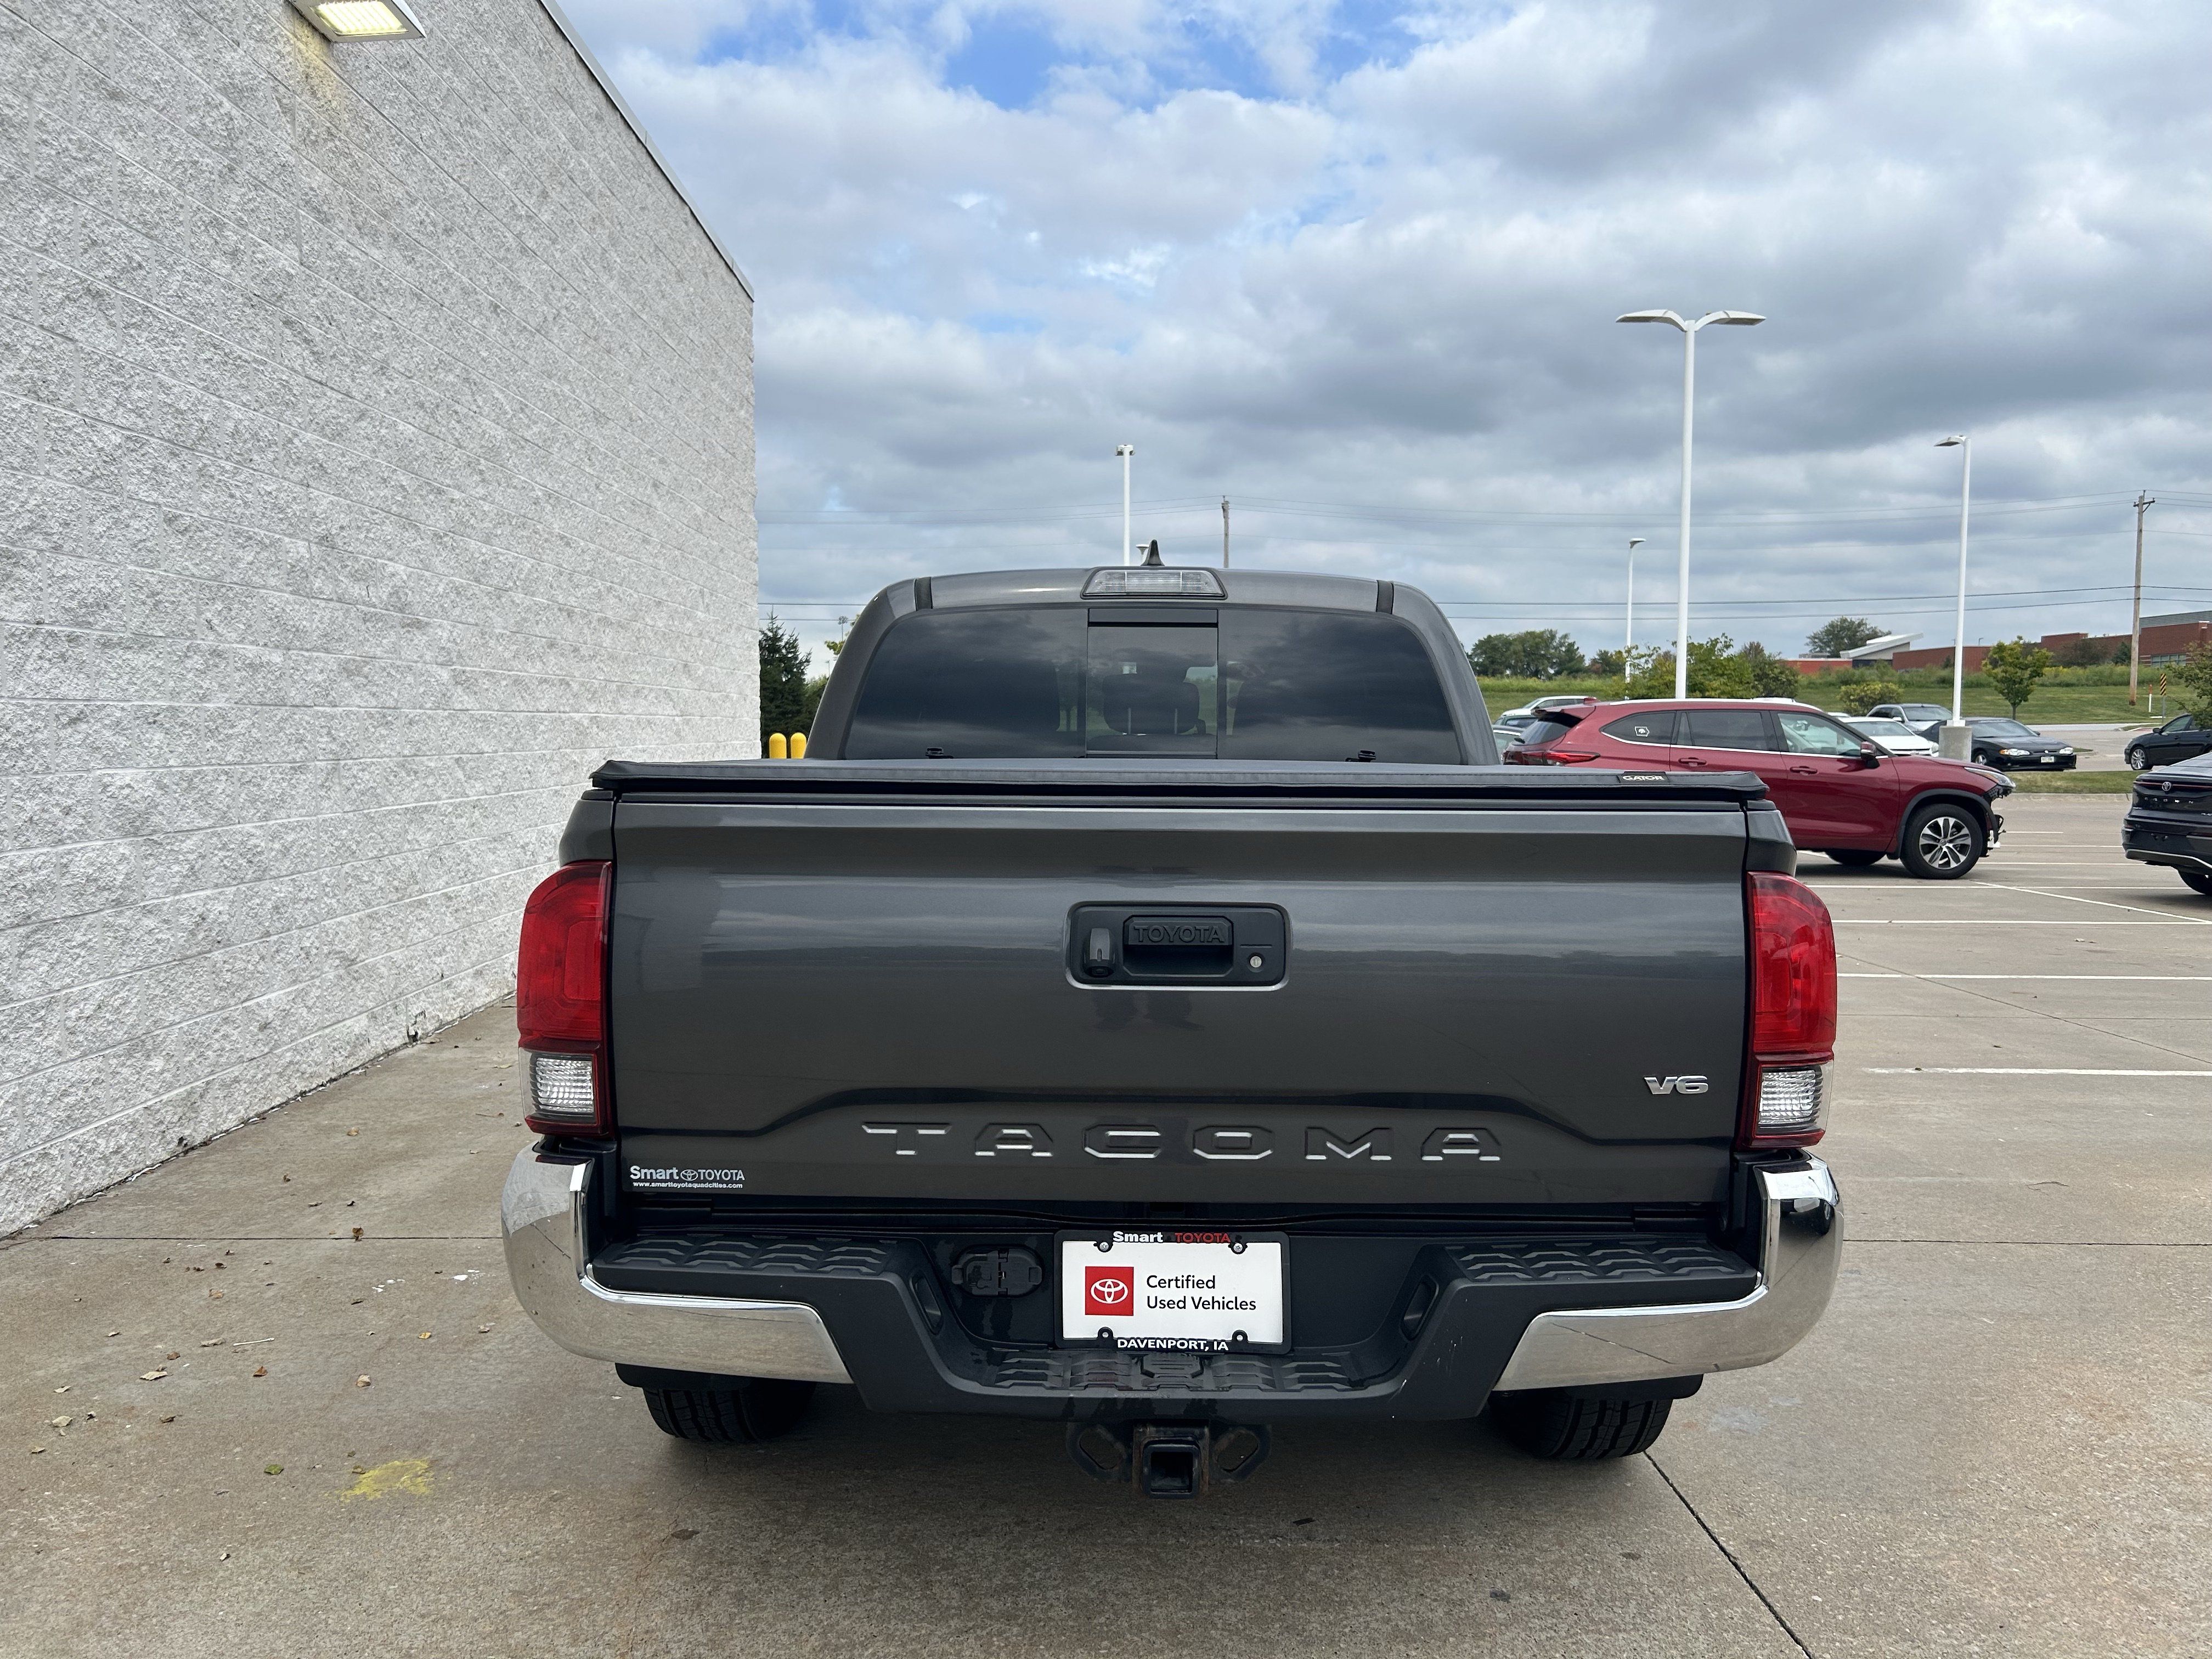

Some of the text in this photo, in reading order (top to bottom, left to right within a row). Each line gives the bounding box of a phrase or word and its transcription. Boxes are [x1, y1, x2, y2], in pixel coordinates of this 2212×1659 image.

[1133, 925, 1224, 943] TOYOTA
[1644, 1075, 1708, 1094] V6
[861, 1122, 1502, 1161] TACOMA
[630, 1165, 745, 1181] Smart TOYOTA
[1113, 1231, 1231, 1244] Smart TOYOTA
[1147, 1275, 1216, 1289] Certified
[1147, 1296, 1256, 1310] Used Vehicles
[1117, 1339, 1229, 1351] DAVENPORT, IA
